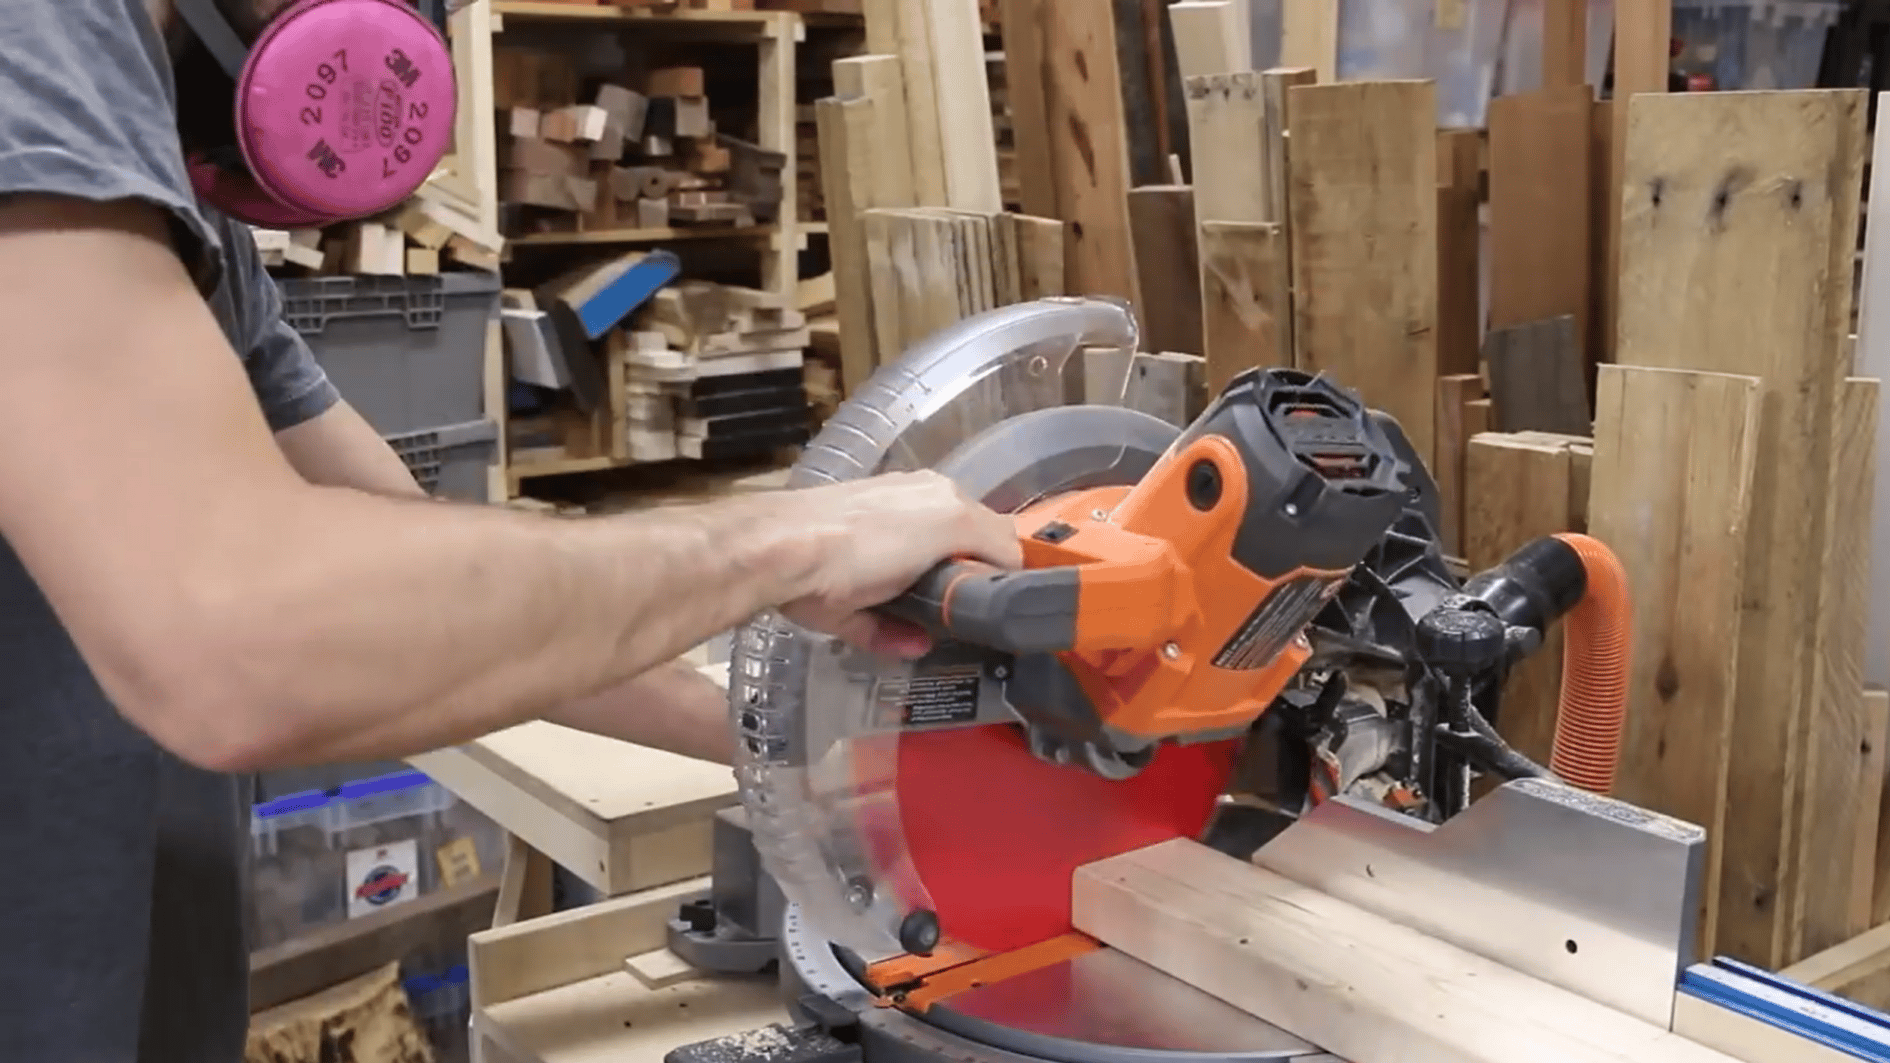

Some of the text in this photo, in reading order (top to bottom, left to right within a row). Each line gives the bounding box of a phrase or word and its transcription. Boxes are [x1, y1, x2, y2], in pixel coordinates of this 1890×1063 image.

[301, 48, 349, 125] 2097
[384, 48, 422, 89] 3M
[306, 137, 346, 179] 3M
[382, 101, 429, 179] 2097
